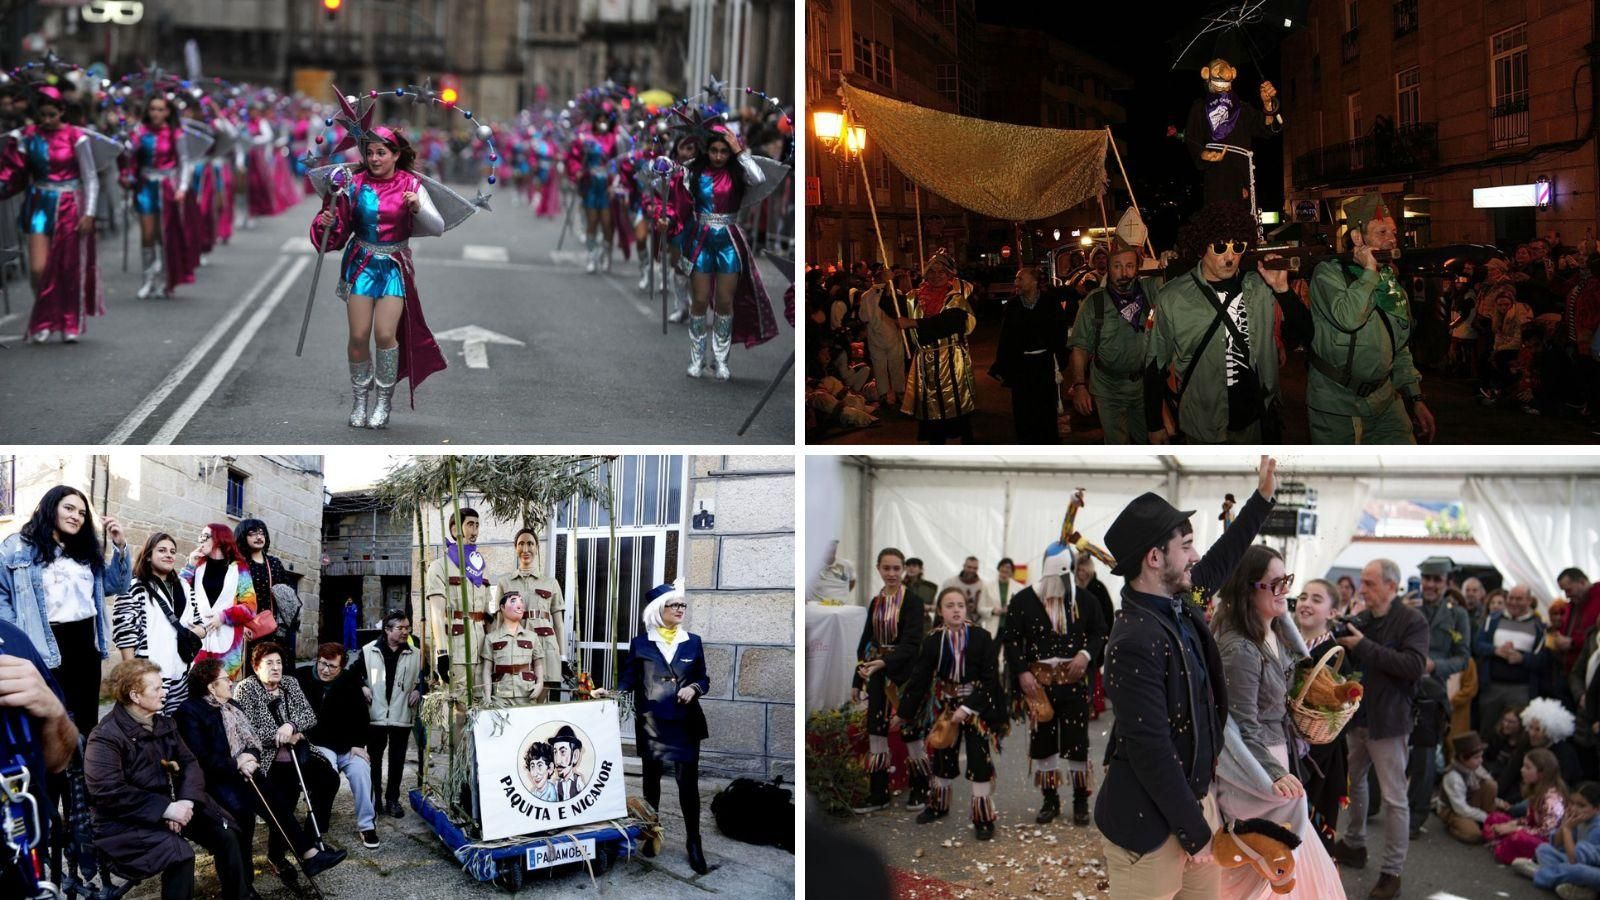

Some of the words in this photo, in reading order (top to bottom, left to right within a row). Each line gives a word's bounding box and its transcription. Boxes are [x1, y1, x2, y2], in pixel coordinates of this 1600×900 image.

[500, 775, 551, 821] PAQUITA
[558, 806, 567, 820] E
[572, 759, 613, 816] NICANOR
[536, 845, 591, 865] PAAMOBL
